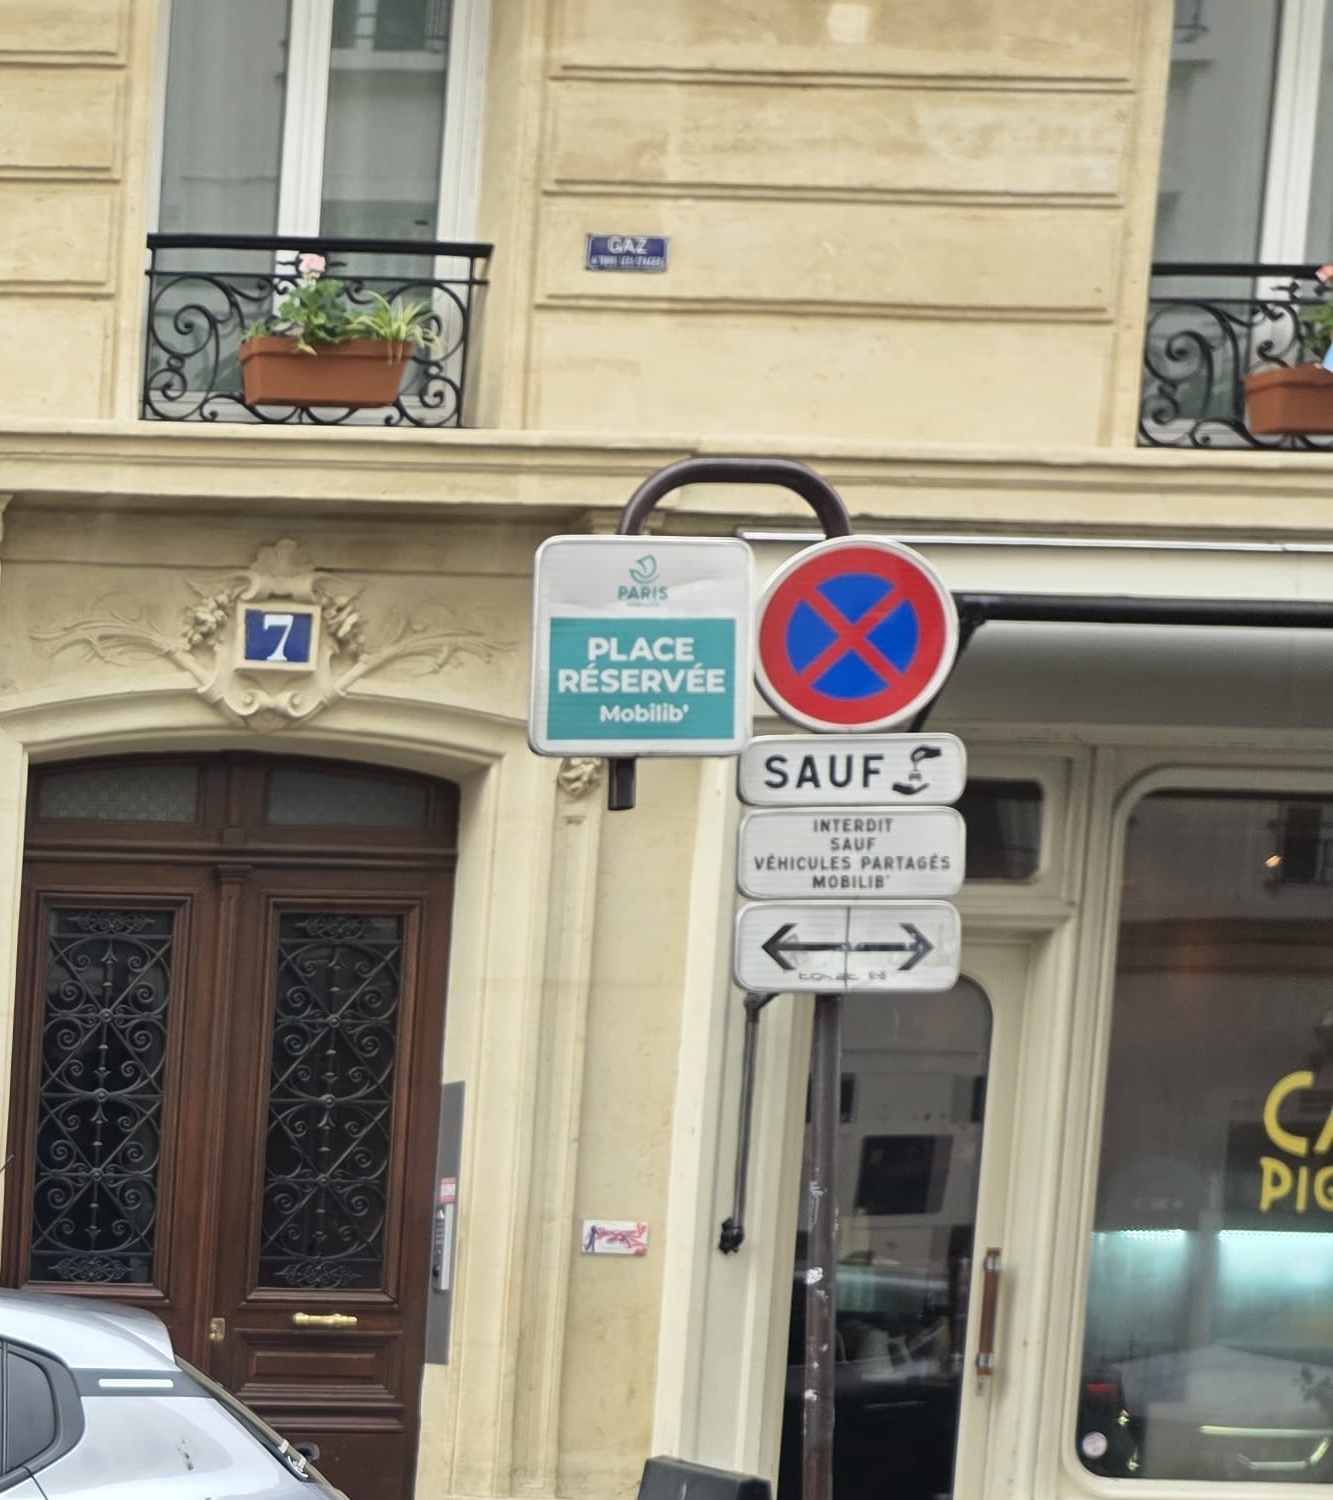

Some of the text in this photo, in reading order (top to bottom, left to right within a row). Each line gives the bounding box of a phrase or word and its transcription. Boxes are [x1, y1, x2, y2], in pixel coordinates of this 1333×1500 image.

[607, 236, 648, 254] GAZ
[618, 585, 668, 601] PARIS
[261, 613, 295, 662] 7
[587, 637, 694, 662] PLACE
[557, 662, 726, 694] RÉSERVÉE
[598, 702, 690, 723] Mobilib'
[763, 754, 886, 790] SAUF
[812, 819, 893, 834] INTERDIT
[830, 838, 876, 852] SAUF
[754, 854, 951, 872] VÉHICULES PARTAGÉS
[812, 874, 891, 890] MOBILIB'
